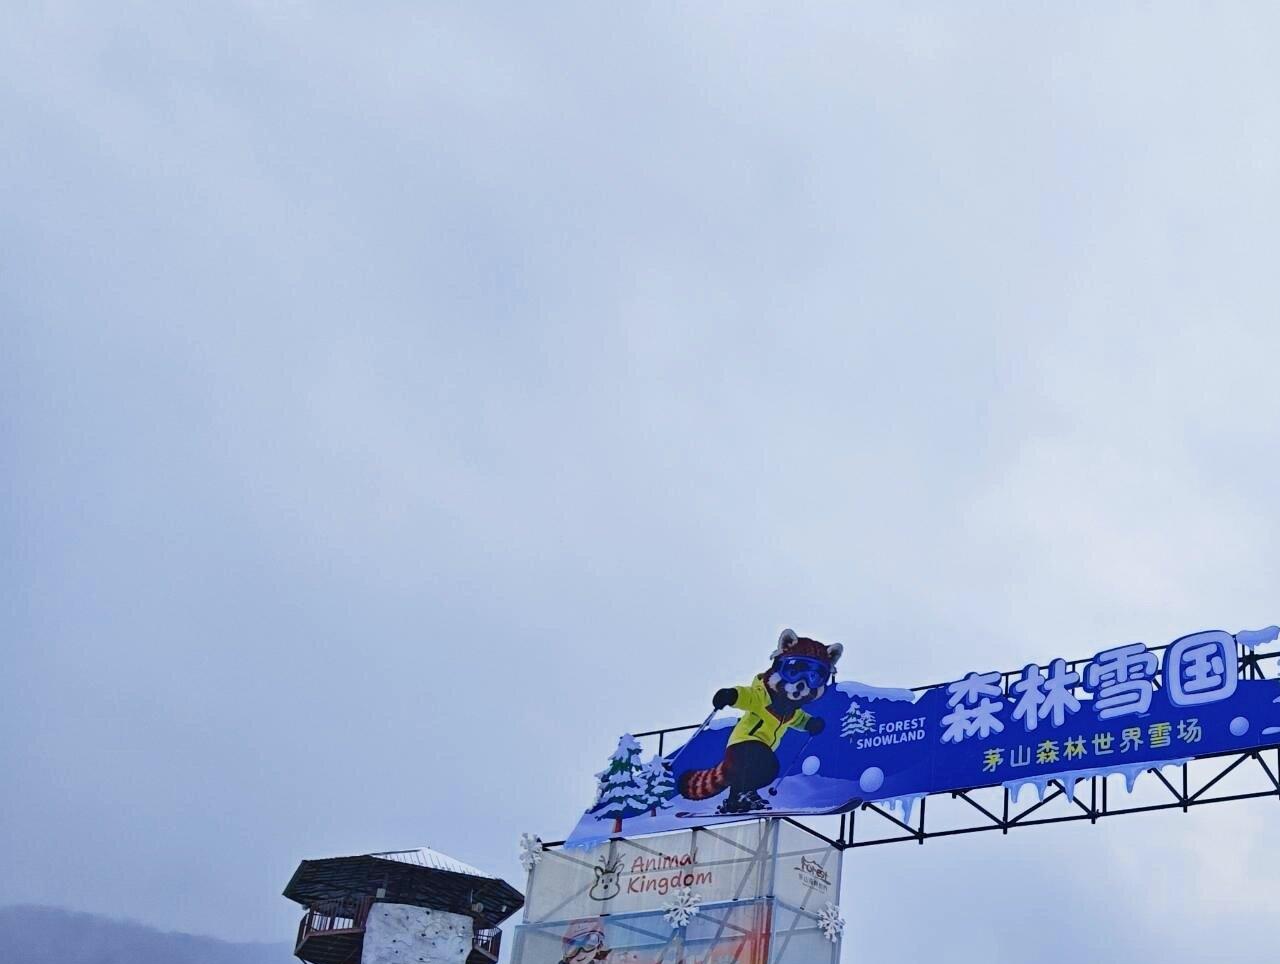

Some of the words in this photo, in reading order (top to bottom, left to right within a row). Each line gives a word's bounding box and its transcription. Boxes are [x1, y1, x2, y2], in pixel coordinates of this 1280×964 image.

[940, 630, 1239, 745] 森林雪国
[878, 716, 927, 735] FOREST
[856, 729, 926, 749] SNOWLAND
[982, 718, 1203, 773] 茅山森林世界雪场
[631, 847, 698, 873] Animal
[627, 870, 713, 896] Kingdom
